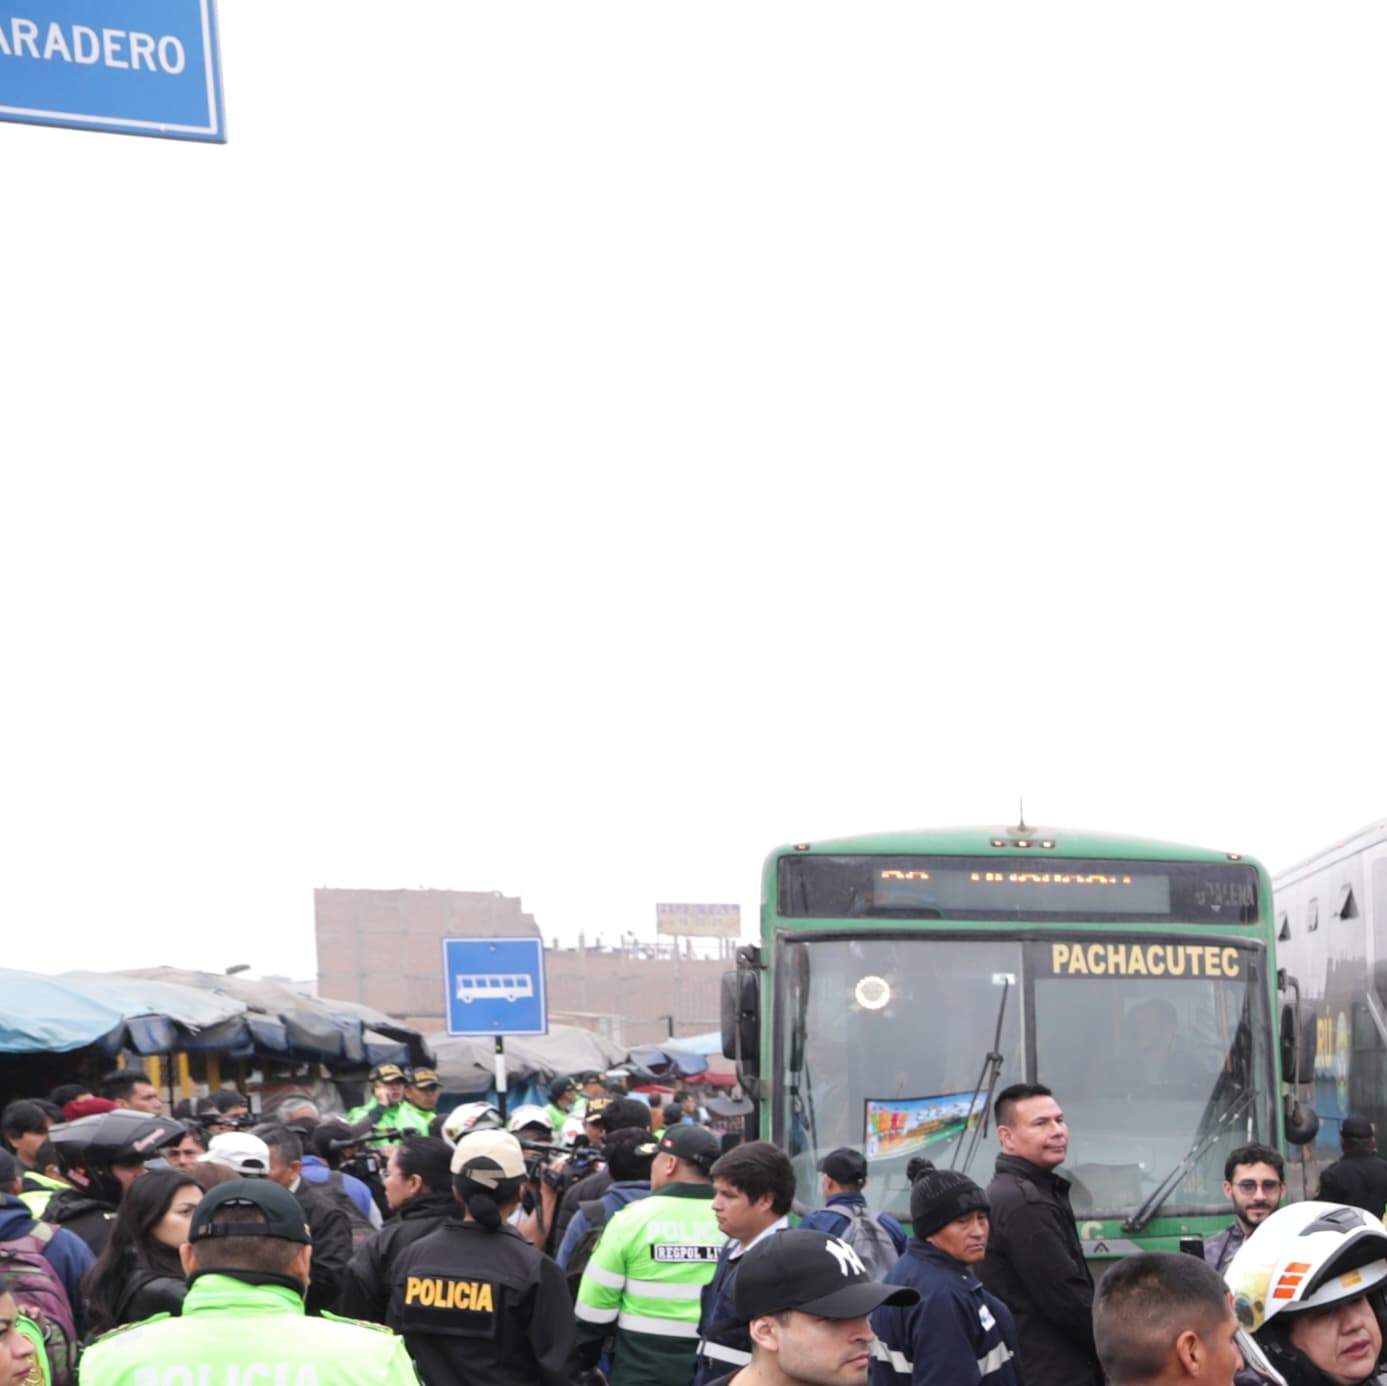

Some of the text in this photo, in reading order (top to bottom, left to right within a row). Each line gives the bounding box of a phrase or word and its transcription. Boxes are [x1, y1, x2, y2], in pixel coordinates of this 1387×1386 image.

[1052, 943, 1240, 977] PACHACUTEC
[646, 1220, 724, 1243] POLIC
[658, 1246, 702, 1260] REGPOL
